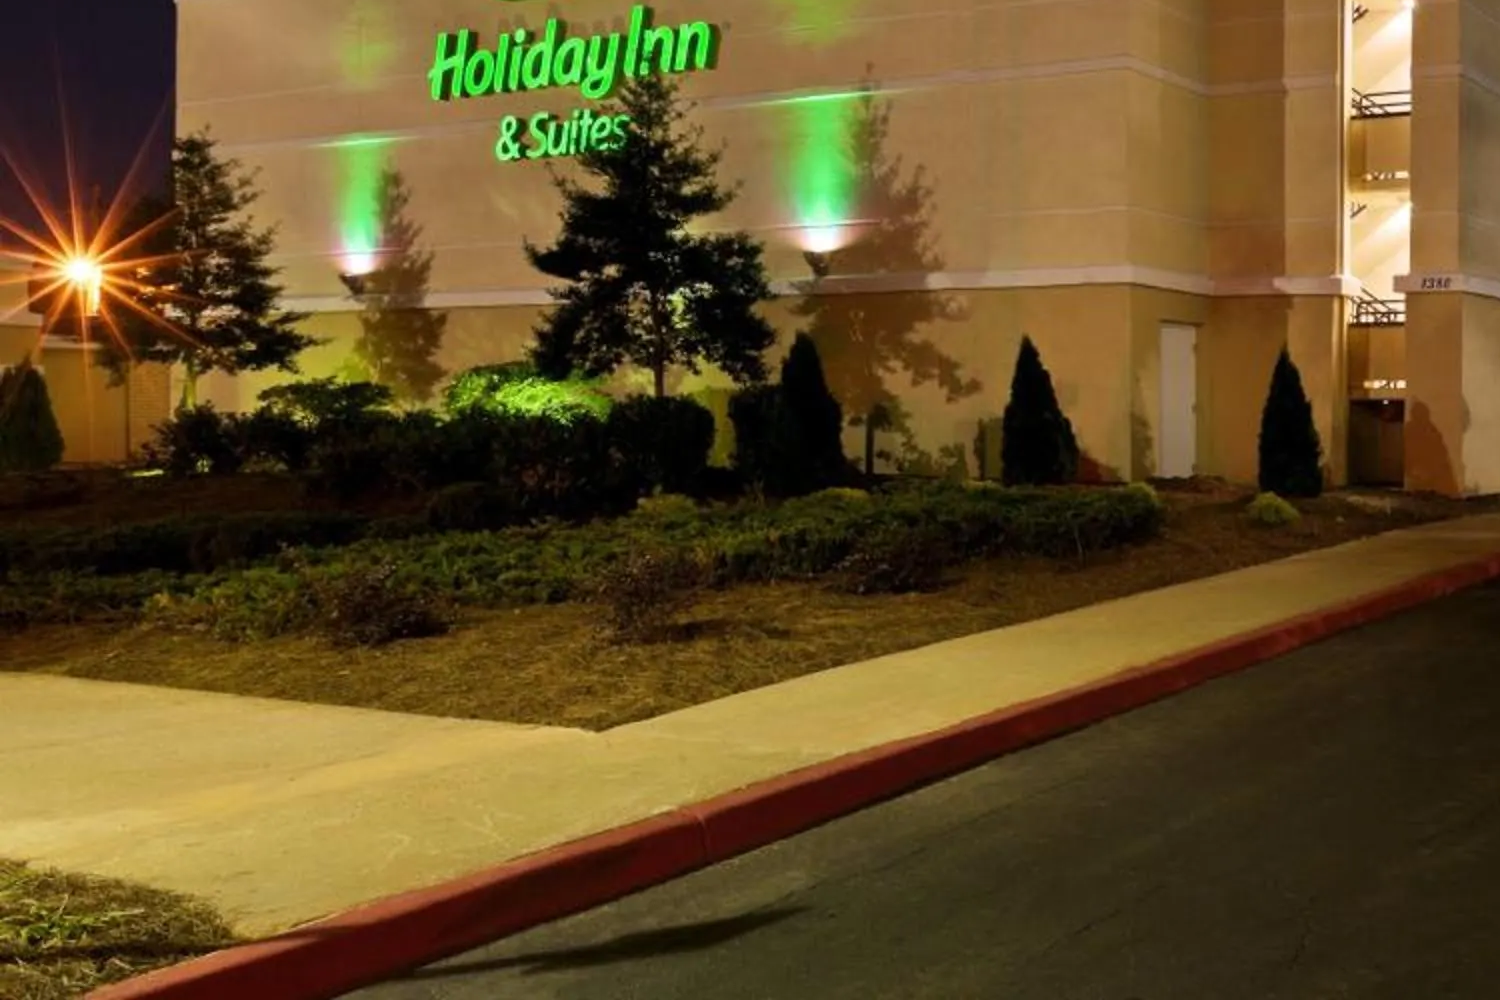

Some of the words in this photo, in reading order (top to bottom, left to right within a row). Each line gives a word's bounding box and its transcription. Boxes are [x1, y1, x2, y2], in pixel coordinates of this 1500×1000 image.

[428, 17, 620, 100] Holiday
[623, 4, 711, 78] Inn
[495, 115, 521, 162] &
[526, 109, 630, 158] Suites
